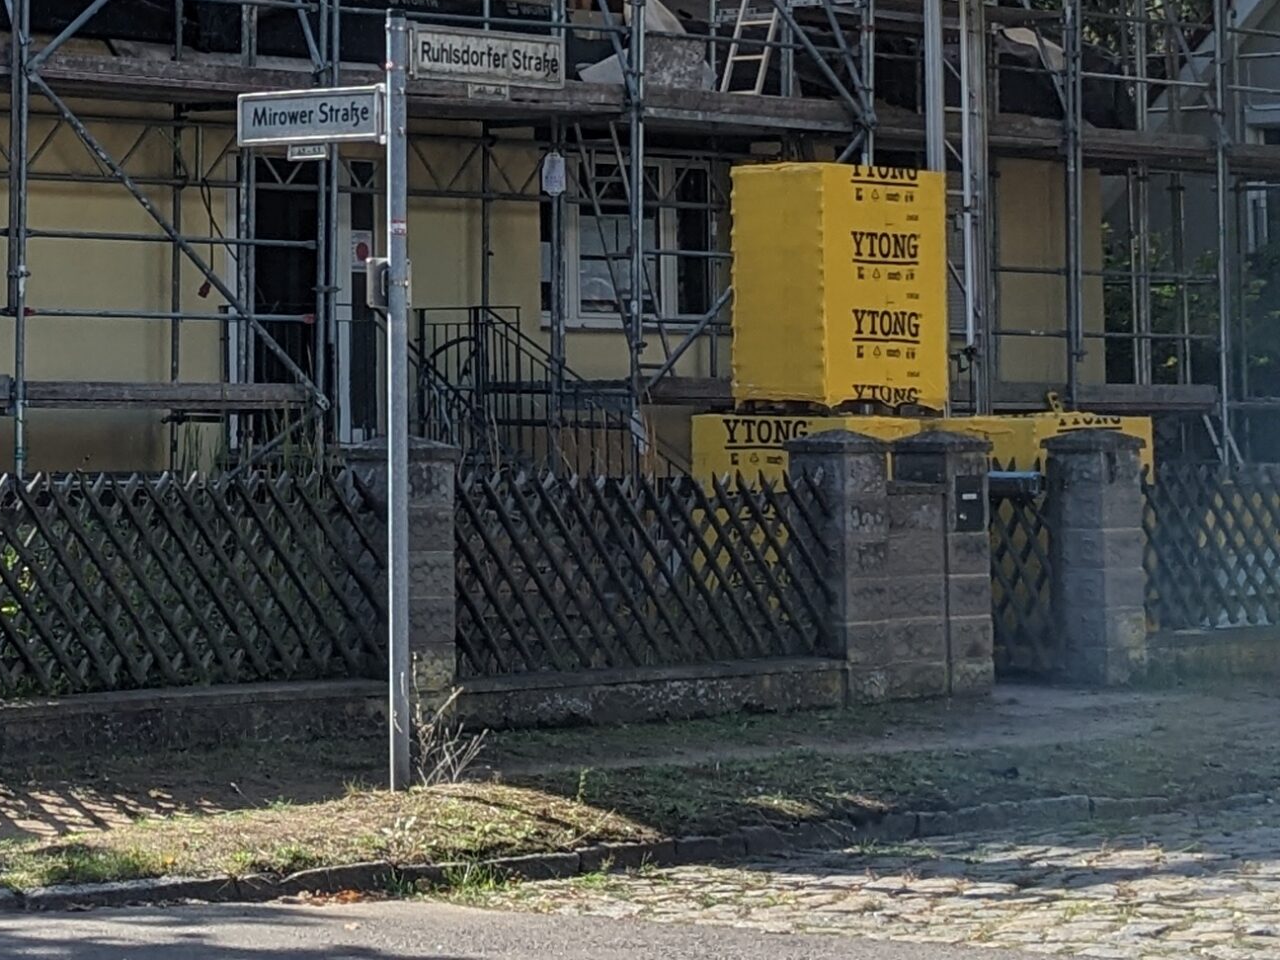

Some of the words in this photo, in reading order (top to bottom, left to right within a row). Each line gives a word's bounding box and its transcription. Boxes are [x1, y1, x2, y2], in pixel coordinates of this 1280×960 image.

[421, 41, 507, 69] Ruhlsdorfer
[512, 49, 559, 76] Straße
[252, 107, 314, 128] Mirower
[319, 101, 369, 127] Straße
[851, 231, 919, 259] YTONG
[852, 309, 920, 338] YTONG
[852, 384, 919, 404] YTONG
[723, 419, 808, 443] YTONG
